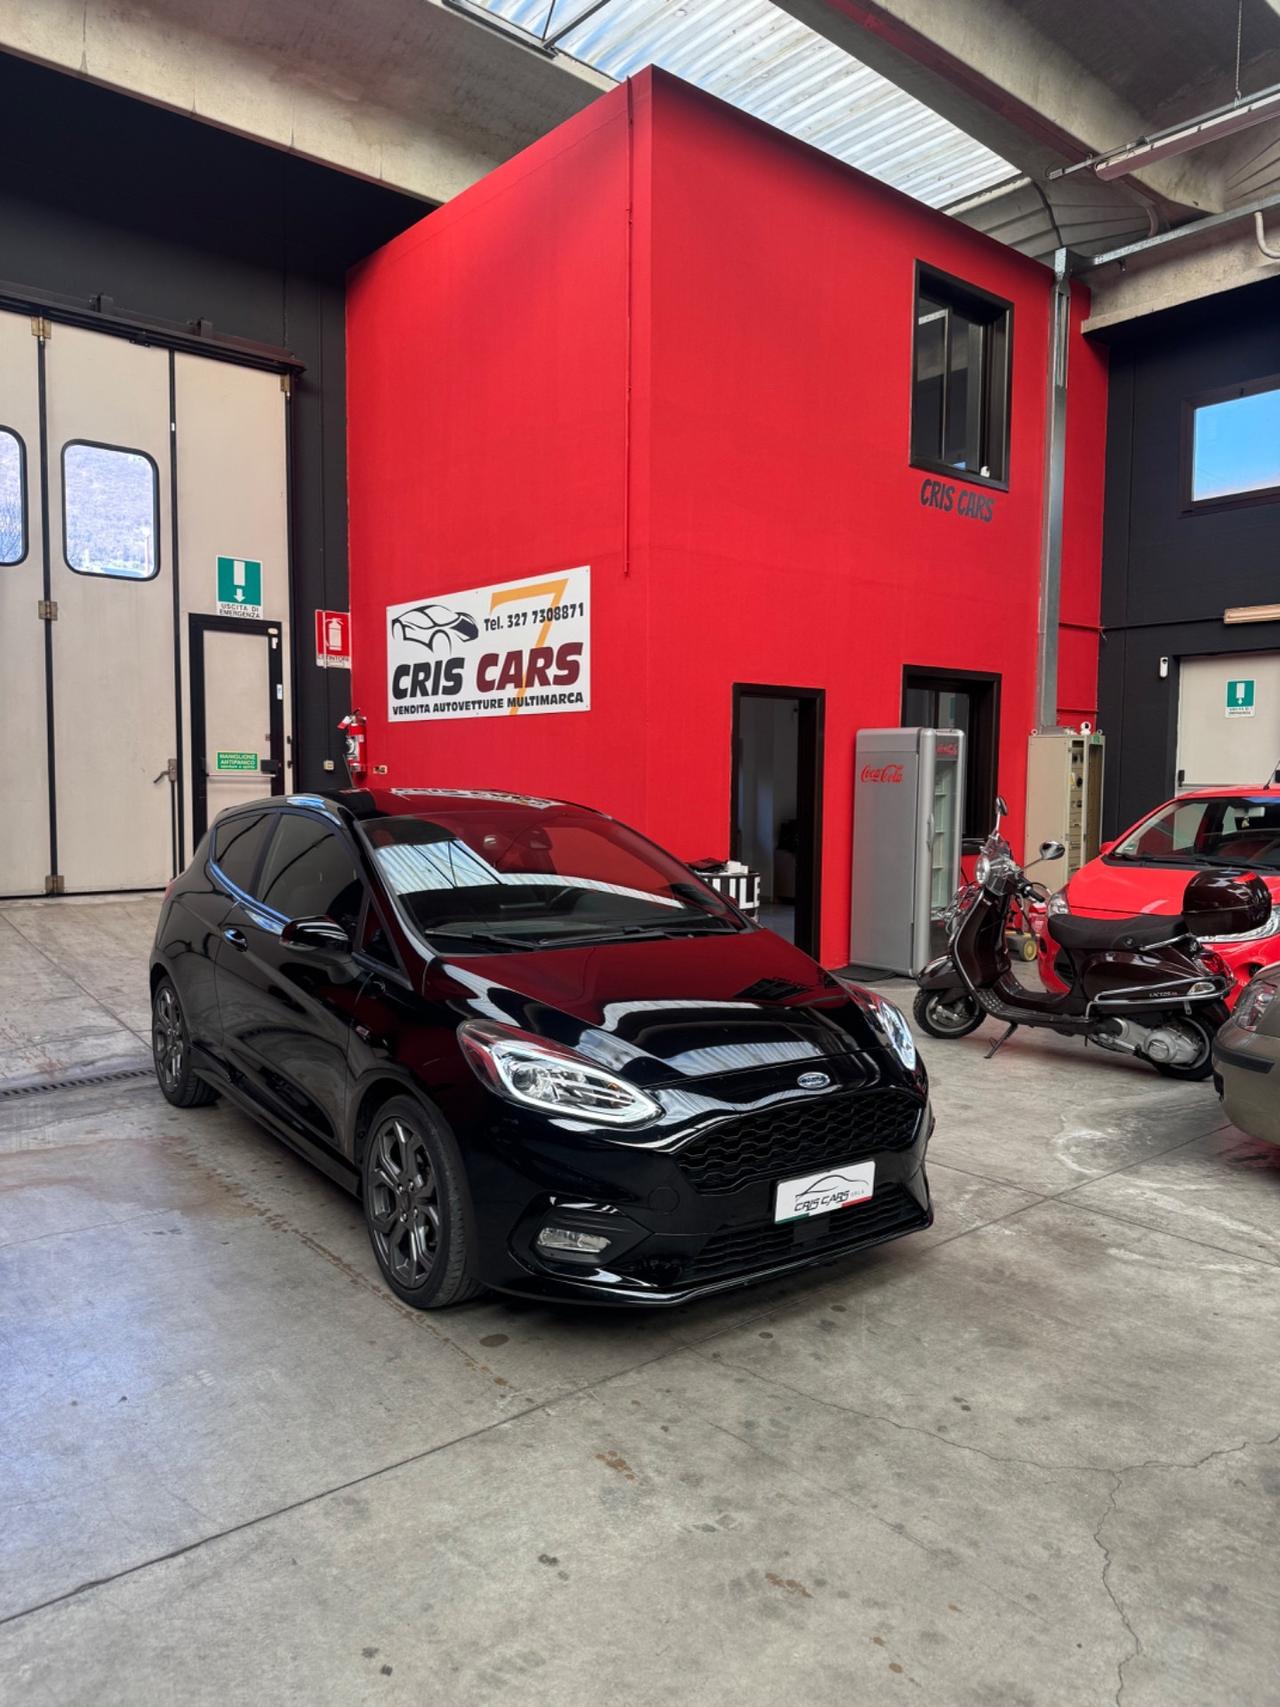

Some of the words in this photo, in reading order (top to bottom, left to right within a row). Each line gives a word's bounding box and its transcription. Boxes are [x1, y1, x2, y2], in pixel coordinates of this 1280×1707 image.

[920, 478, 955, 512] CRIS
[957, 489, 995, 523] CARS
[219, 609, 261, 618] EMERGENZA
[221, 603, 248, 611] USCITA
[484, 616, 504, 632] Tel.
[507, 612, 528, 629] 327
[532, 602, 584, 624] 7308871
[392, 657, 465, 700] CRIS
[476, 642, 584, 693] CARS
[392, 703, 430, 715] VENDITA
[432, 698, 504, 713] AUTOVETTURE
[507, 692, 584, 708] MULTIMARCA
